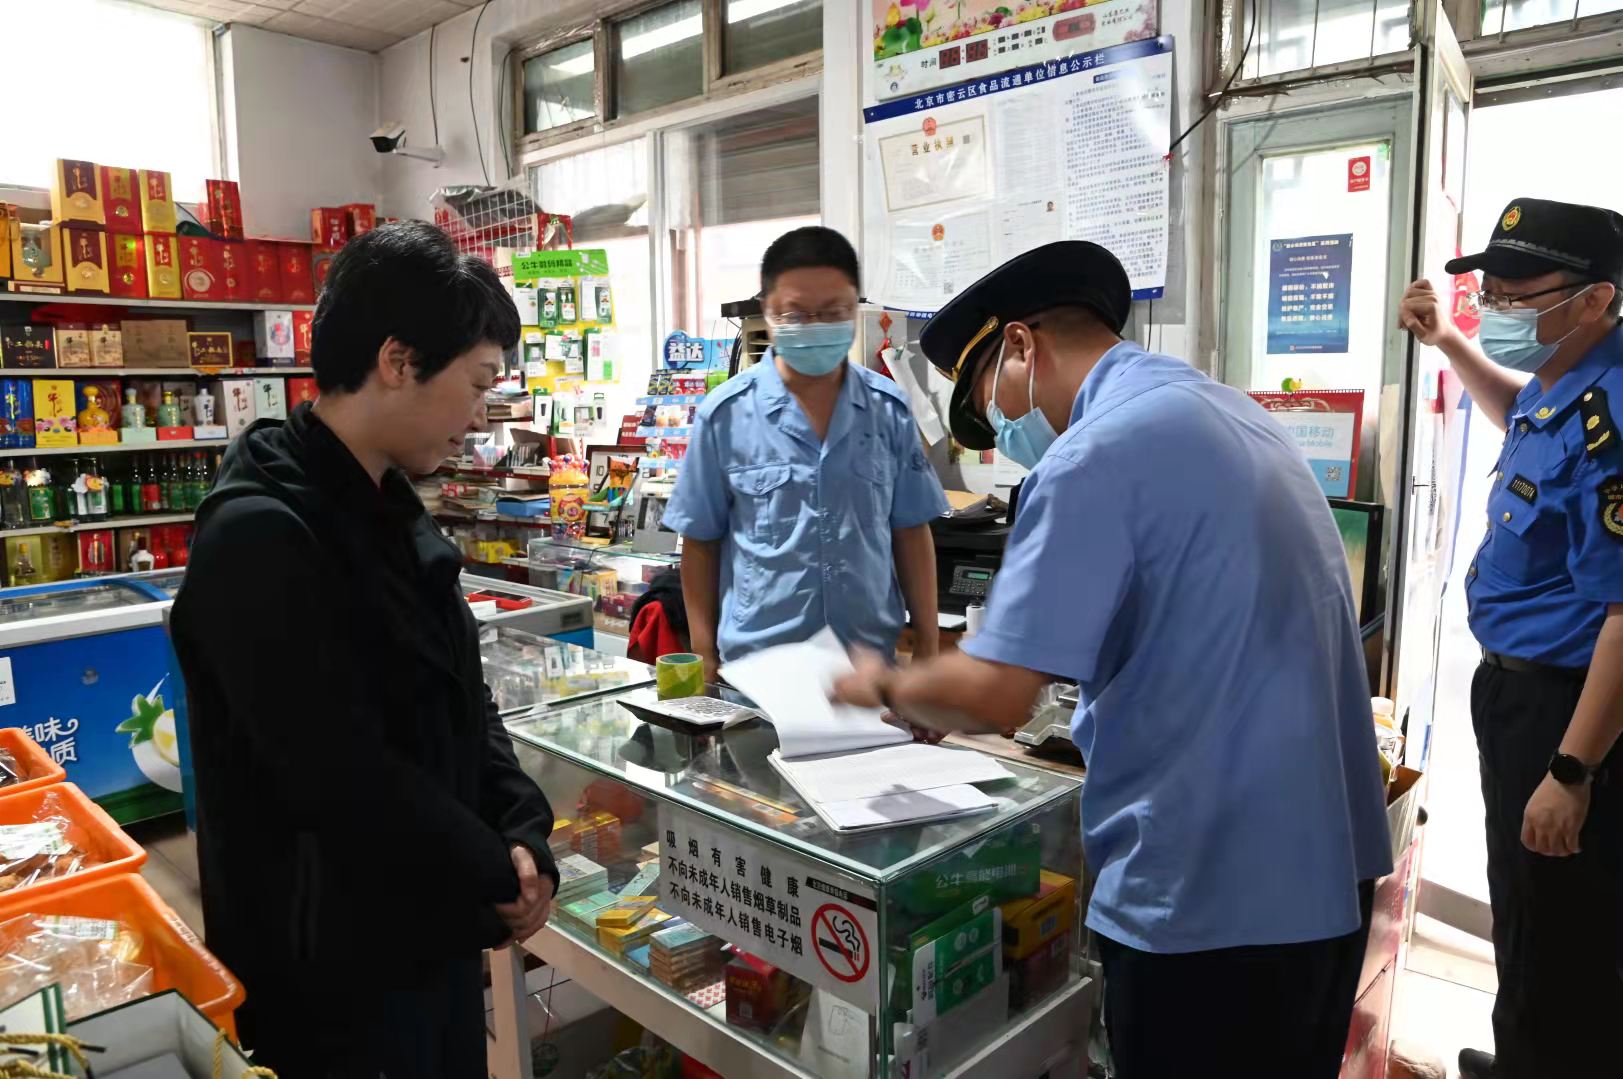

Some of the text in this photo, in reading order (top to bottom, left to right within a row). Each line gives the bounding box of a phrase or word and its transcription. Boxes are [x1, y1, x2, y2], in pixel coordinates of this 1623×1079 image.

[914, 52, 1105, 109] 北京市密云区食品流通单位信息公示栏
[921, 57, 937, 68] 时间
[911, 135, 954, 156] 营业执照
[668, 341, 704, 362] 益达
[666, 830, 799, 898] 吸烟有害健康
[668, 855, 801, 928] 不向未成年人销售烟草制品
[669, 881, 803, 956] 不向未成年人销售电子烟
